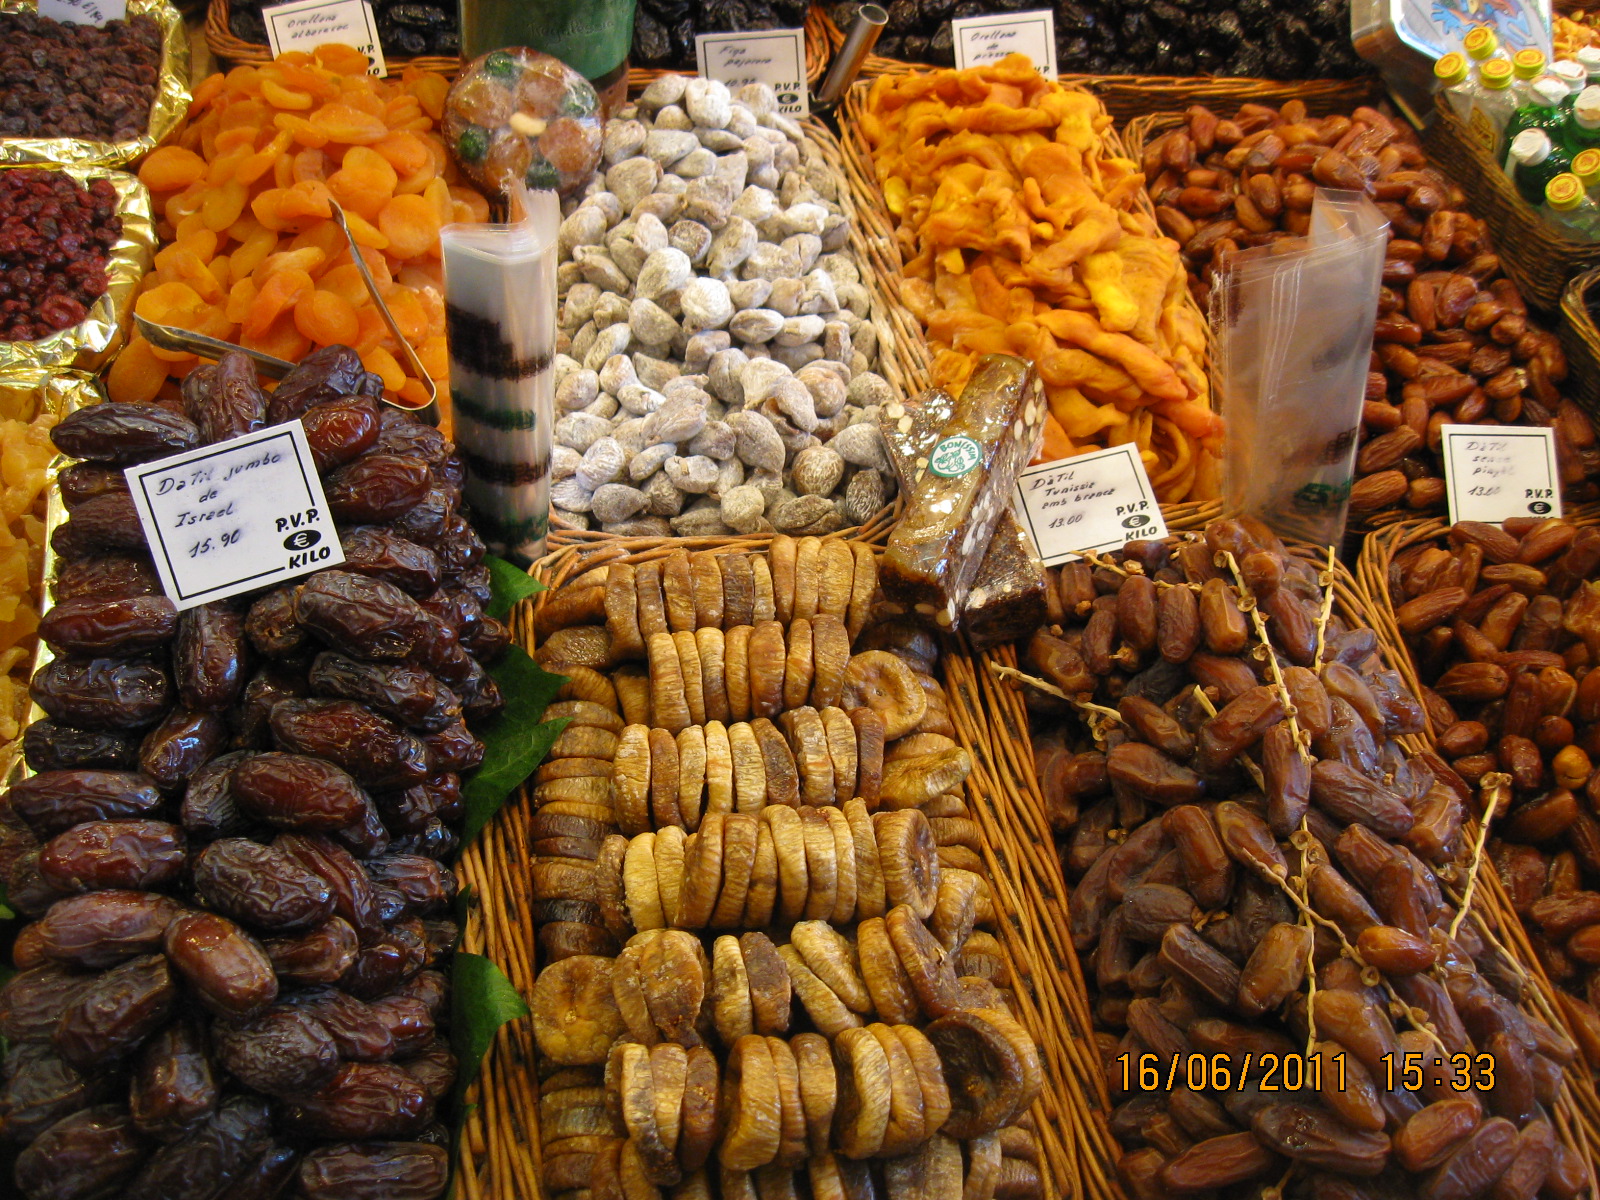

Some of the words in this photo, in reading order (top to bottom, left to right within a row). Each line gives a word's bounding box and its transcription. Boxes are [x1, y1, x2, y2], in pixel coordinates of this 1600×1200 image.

[774, 82, 801, 92] P.V.P.
[223, 453, 282, 481] jumbo
[199, 488, 218, 503] de
[1525, 489, 1553, 499] P.V.P.
[175, 502, 234, 528] Israel
[1116, 500, 1149, 516] P.V.P.
[275, 508, 320, 533] P.V.P.
[1049, 514, 1083, 529] 13.00
[1125, 526, 1158, 541] KILO
[189, 528, 241, 558] 15.90
[288, 546, 331, 570] KILO
